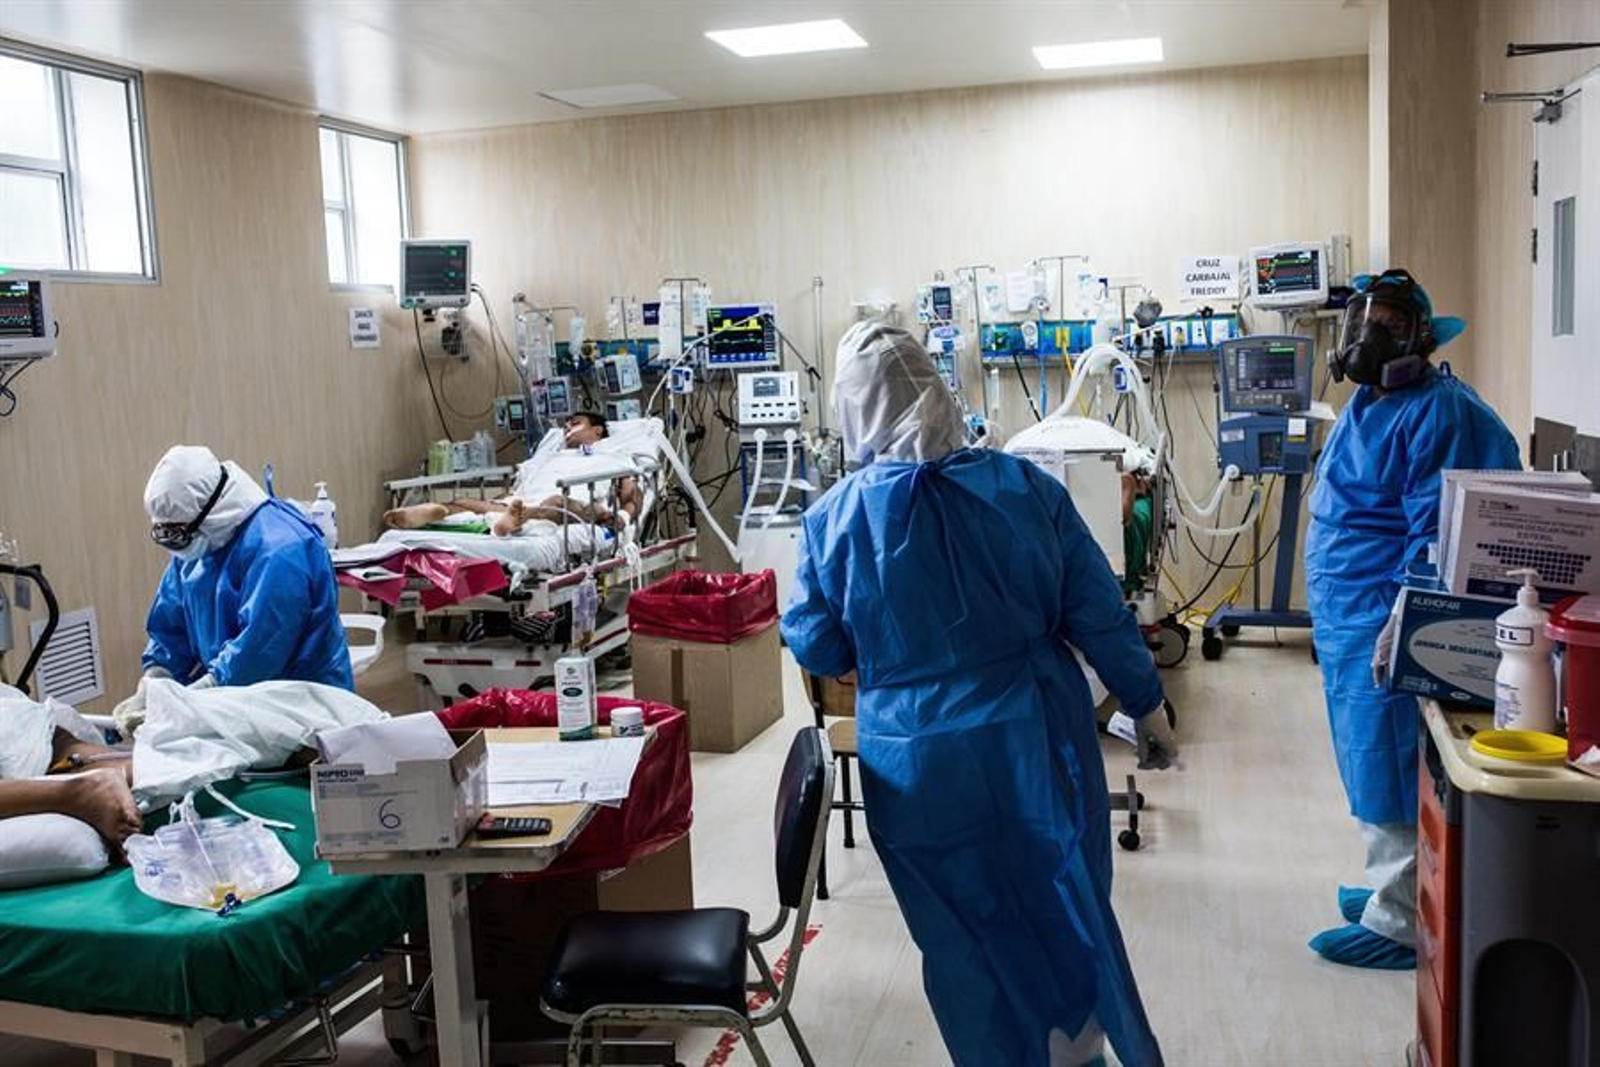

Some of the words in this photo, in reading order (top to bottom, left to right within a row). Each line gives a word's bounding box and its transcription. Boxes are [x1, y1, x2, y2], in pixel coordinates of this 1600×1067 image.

[1195, 259, 1221, 268] CRUZ
[1185, 272, 1231, 282] CARBAJAL
[1191, 287, 1227, 296] FREDDY
[379, 799, 401, 829] 6
